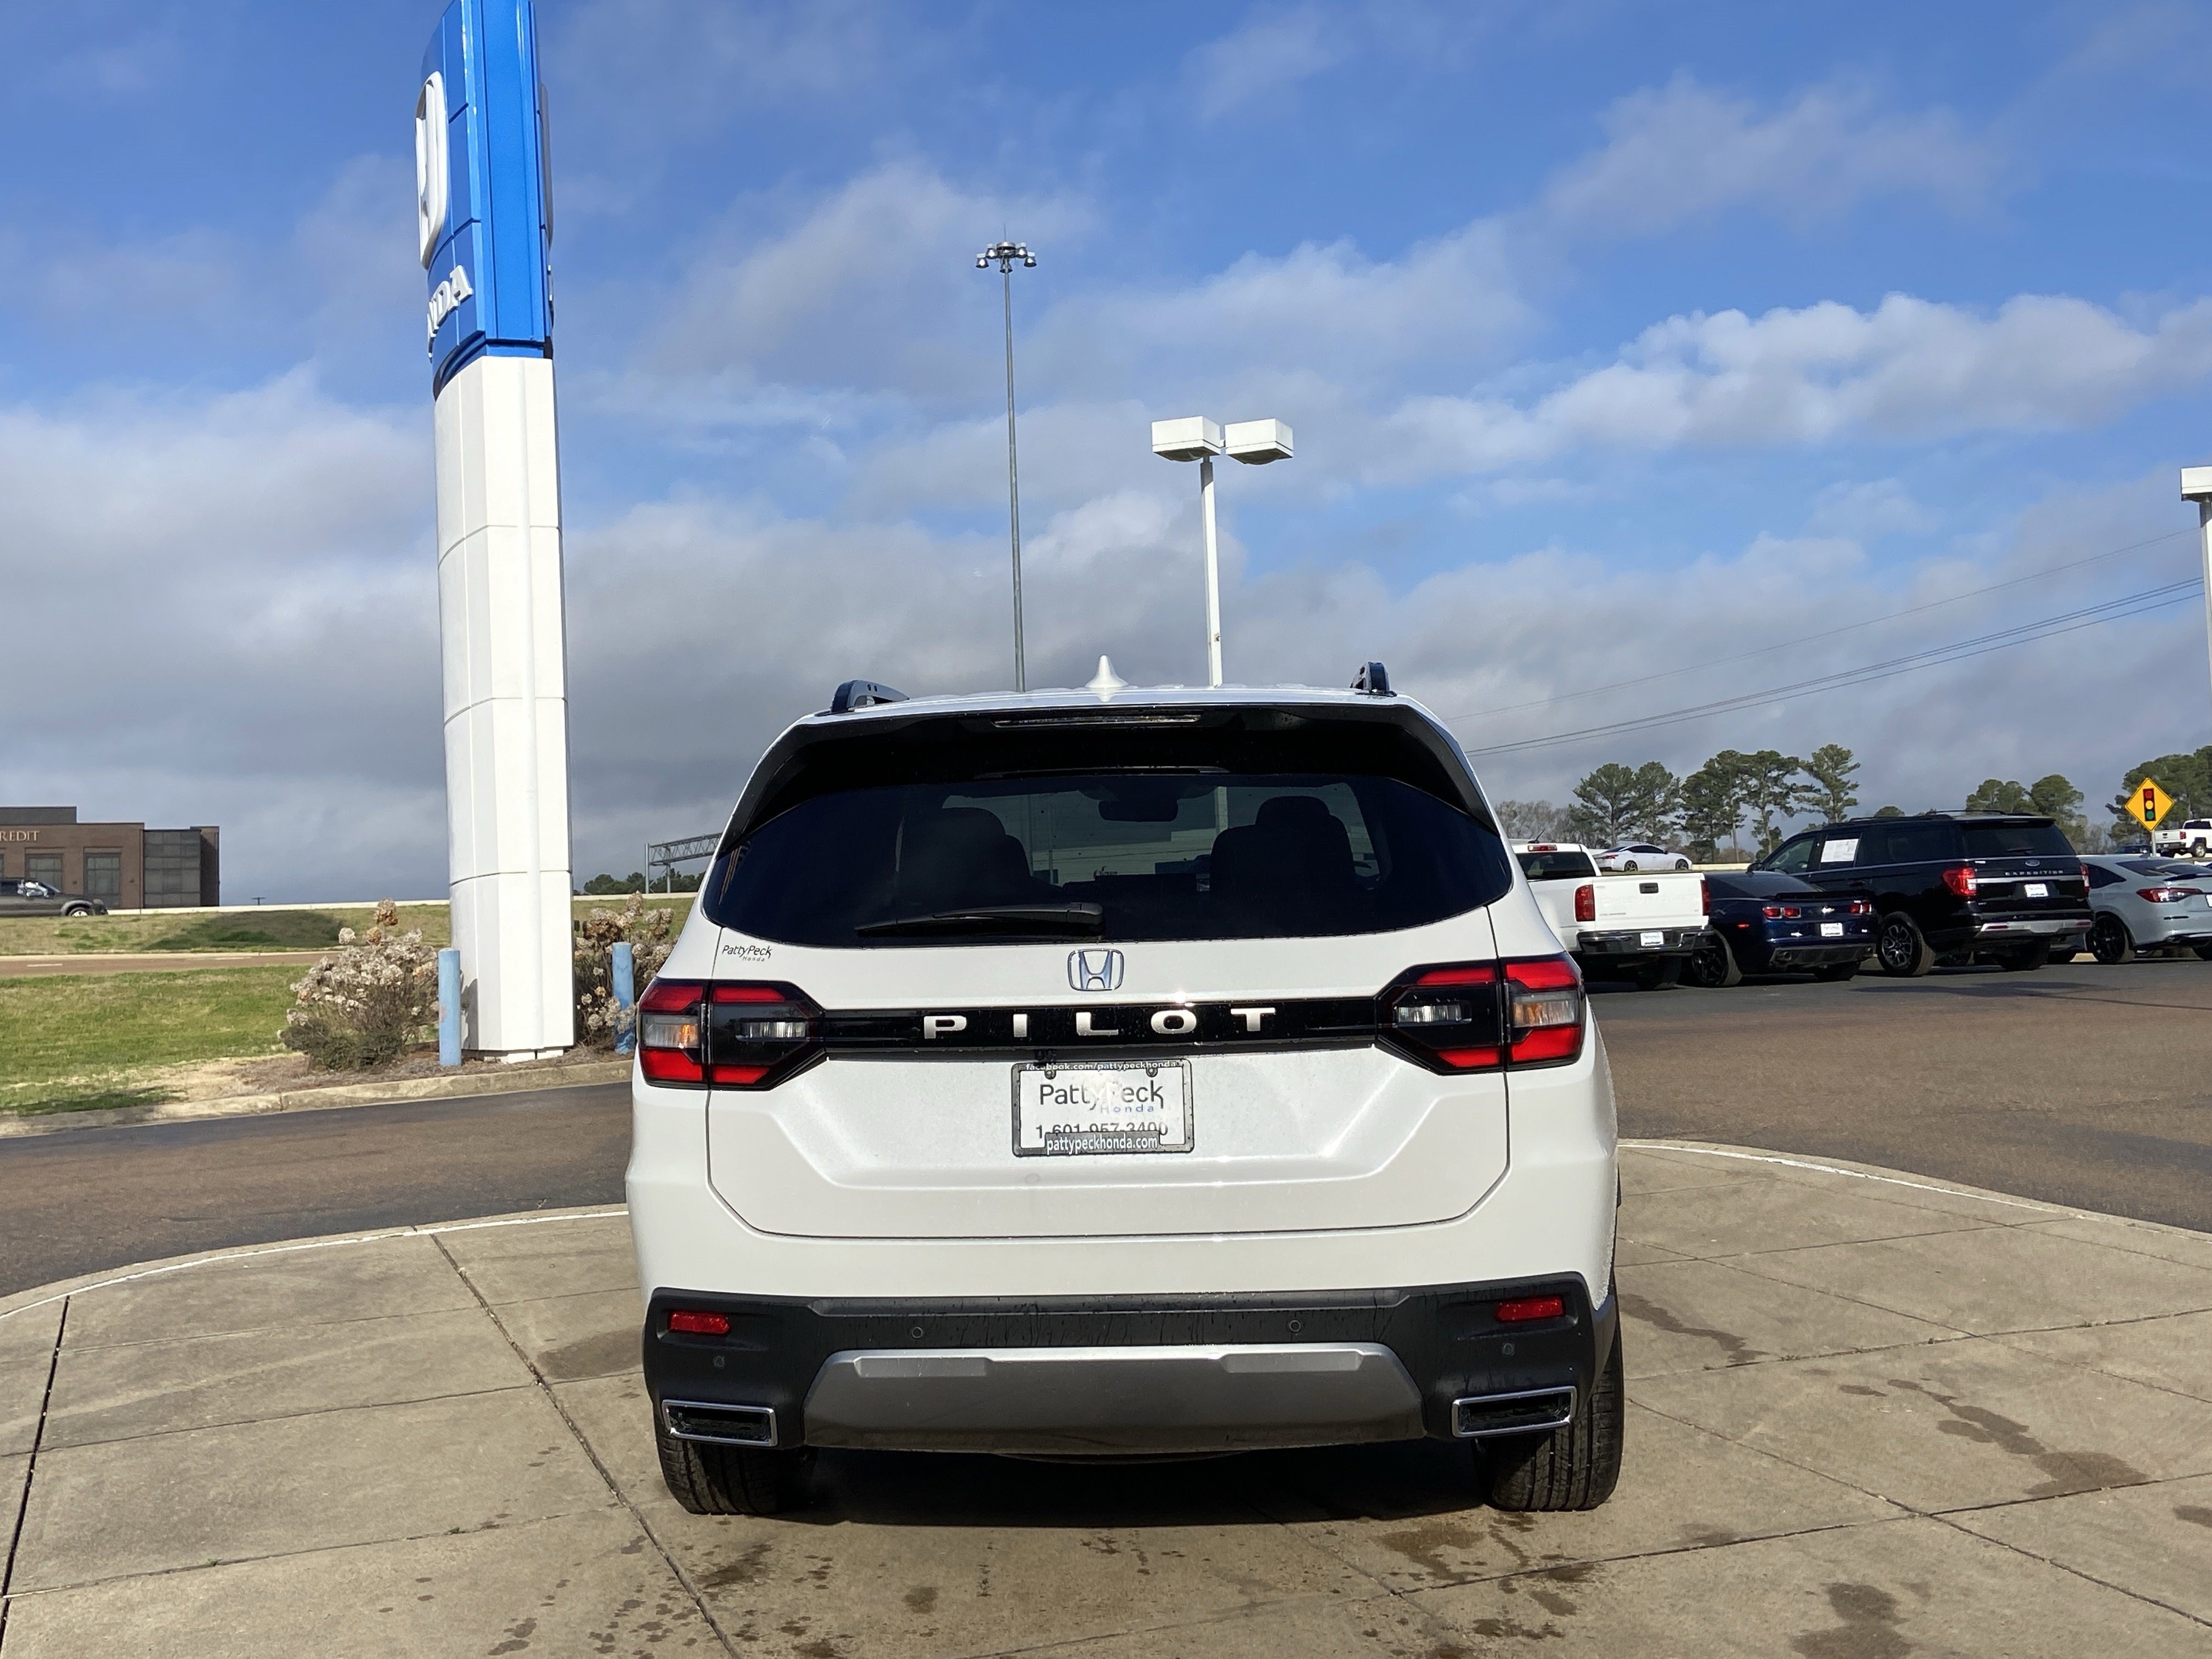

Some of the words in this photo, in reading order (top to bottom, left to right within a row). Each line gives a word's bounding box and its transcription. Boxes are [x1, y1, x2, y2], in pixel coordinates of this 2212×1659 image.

[0, 830, 40, 841] REDIT
[721, 945, 772, 959] PattyPeck
[923, 1007, 1276, 1039] PILOT
[1040, 1080, 1164, 1110] PattyPeck
[1101, 1103, 1154, 1113] Honda
[1047, 1132, 1158, 1155] pattypeckhonda.com
